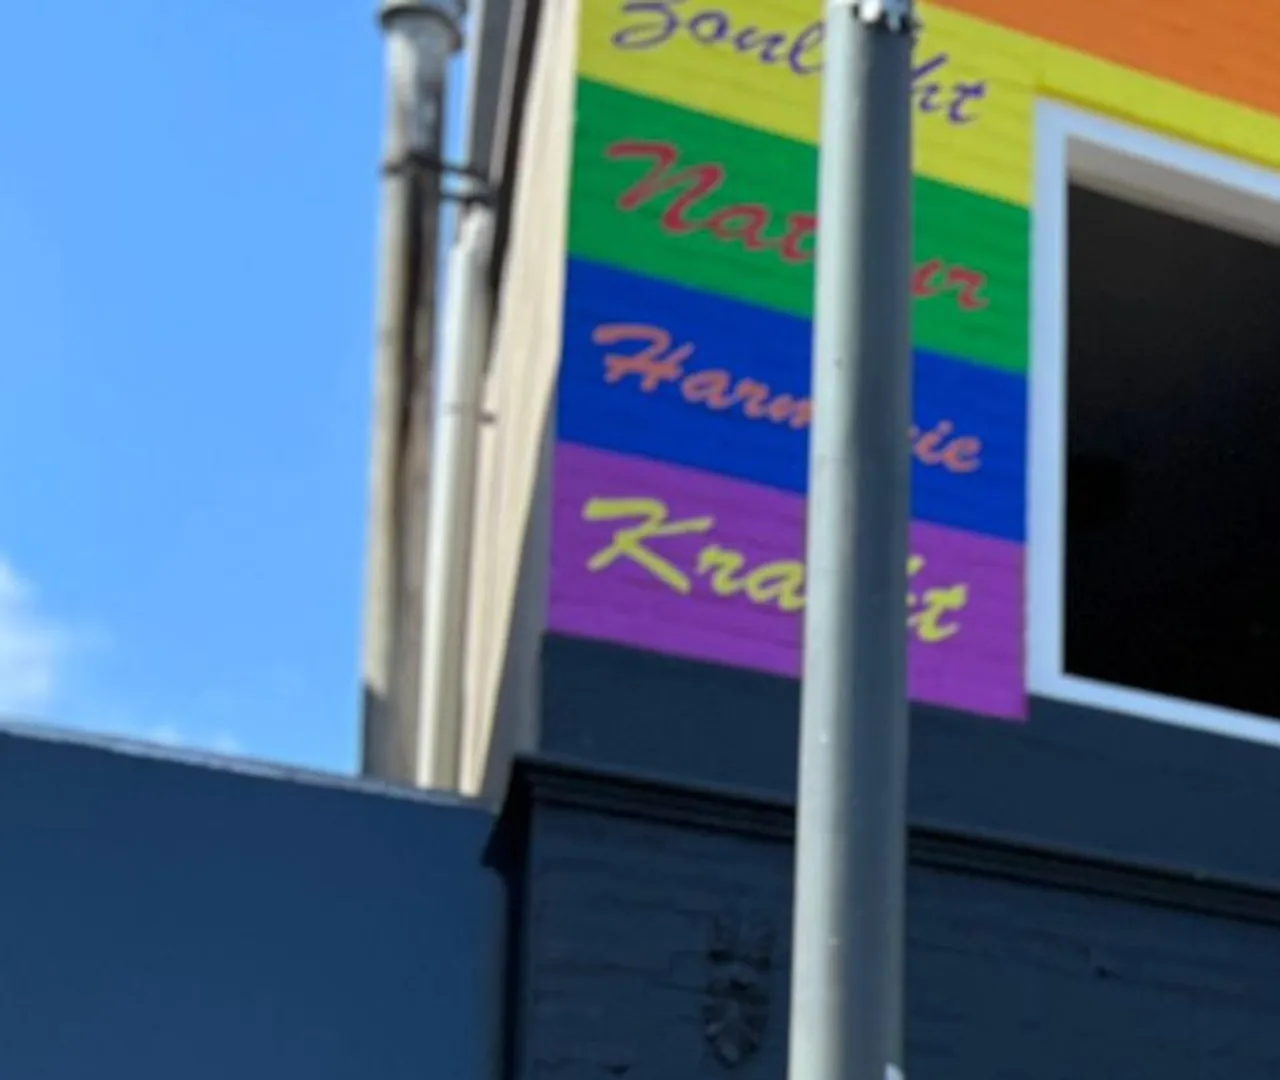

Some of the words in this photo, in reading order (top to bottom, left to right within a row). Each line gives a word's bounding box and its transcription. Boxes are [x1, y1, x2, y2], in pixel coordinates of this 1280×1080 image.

[611, 0, 986, 125] Zonlht
[605, 139, 989, 310] Natr
[592, 323, 981, 473] Harmie
[582, 497, 968, 642] Krat
